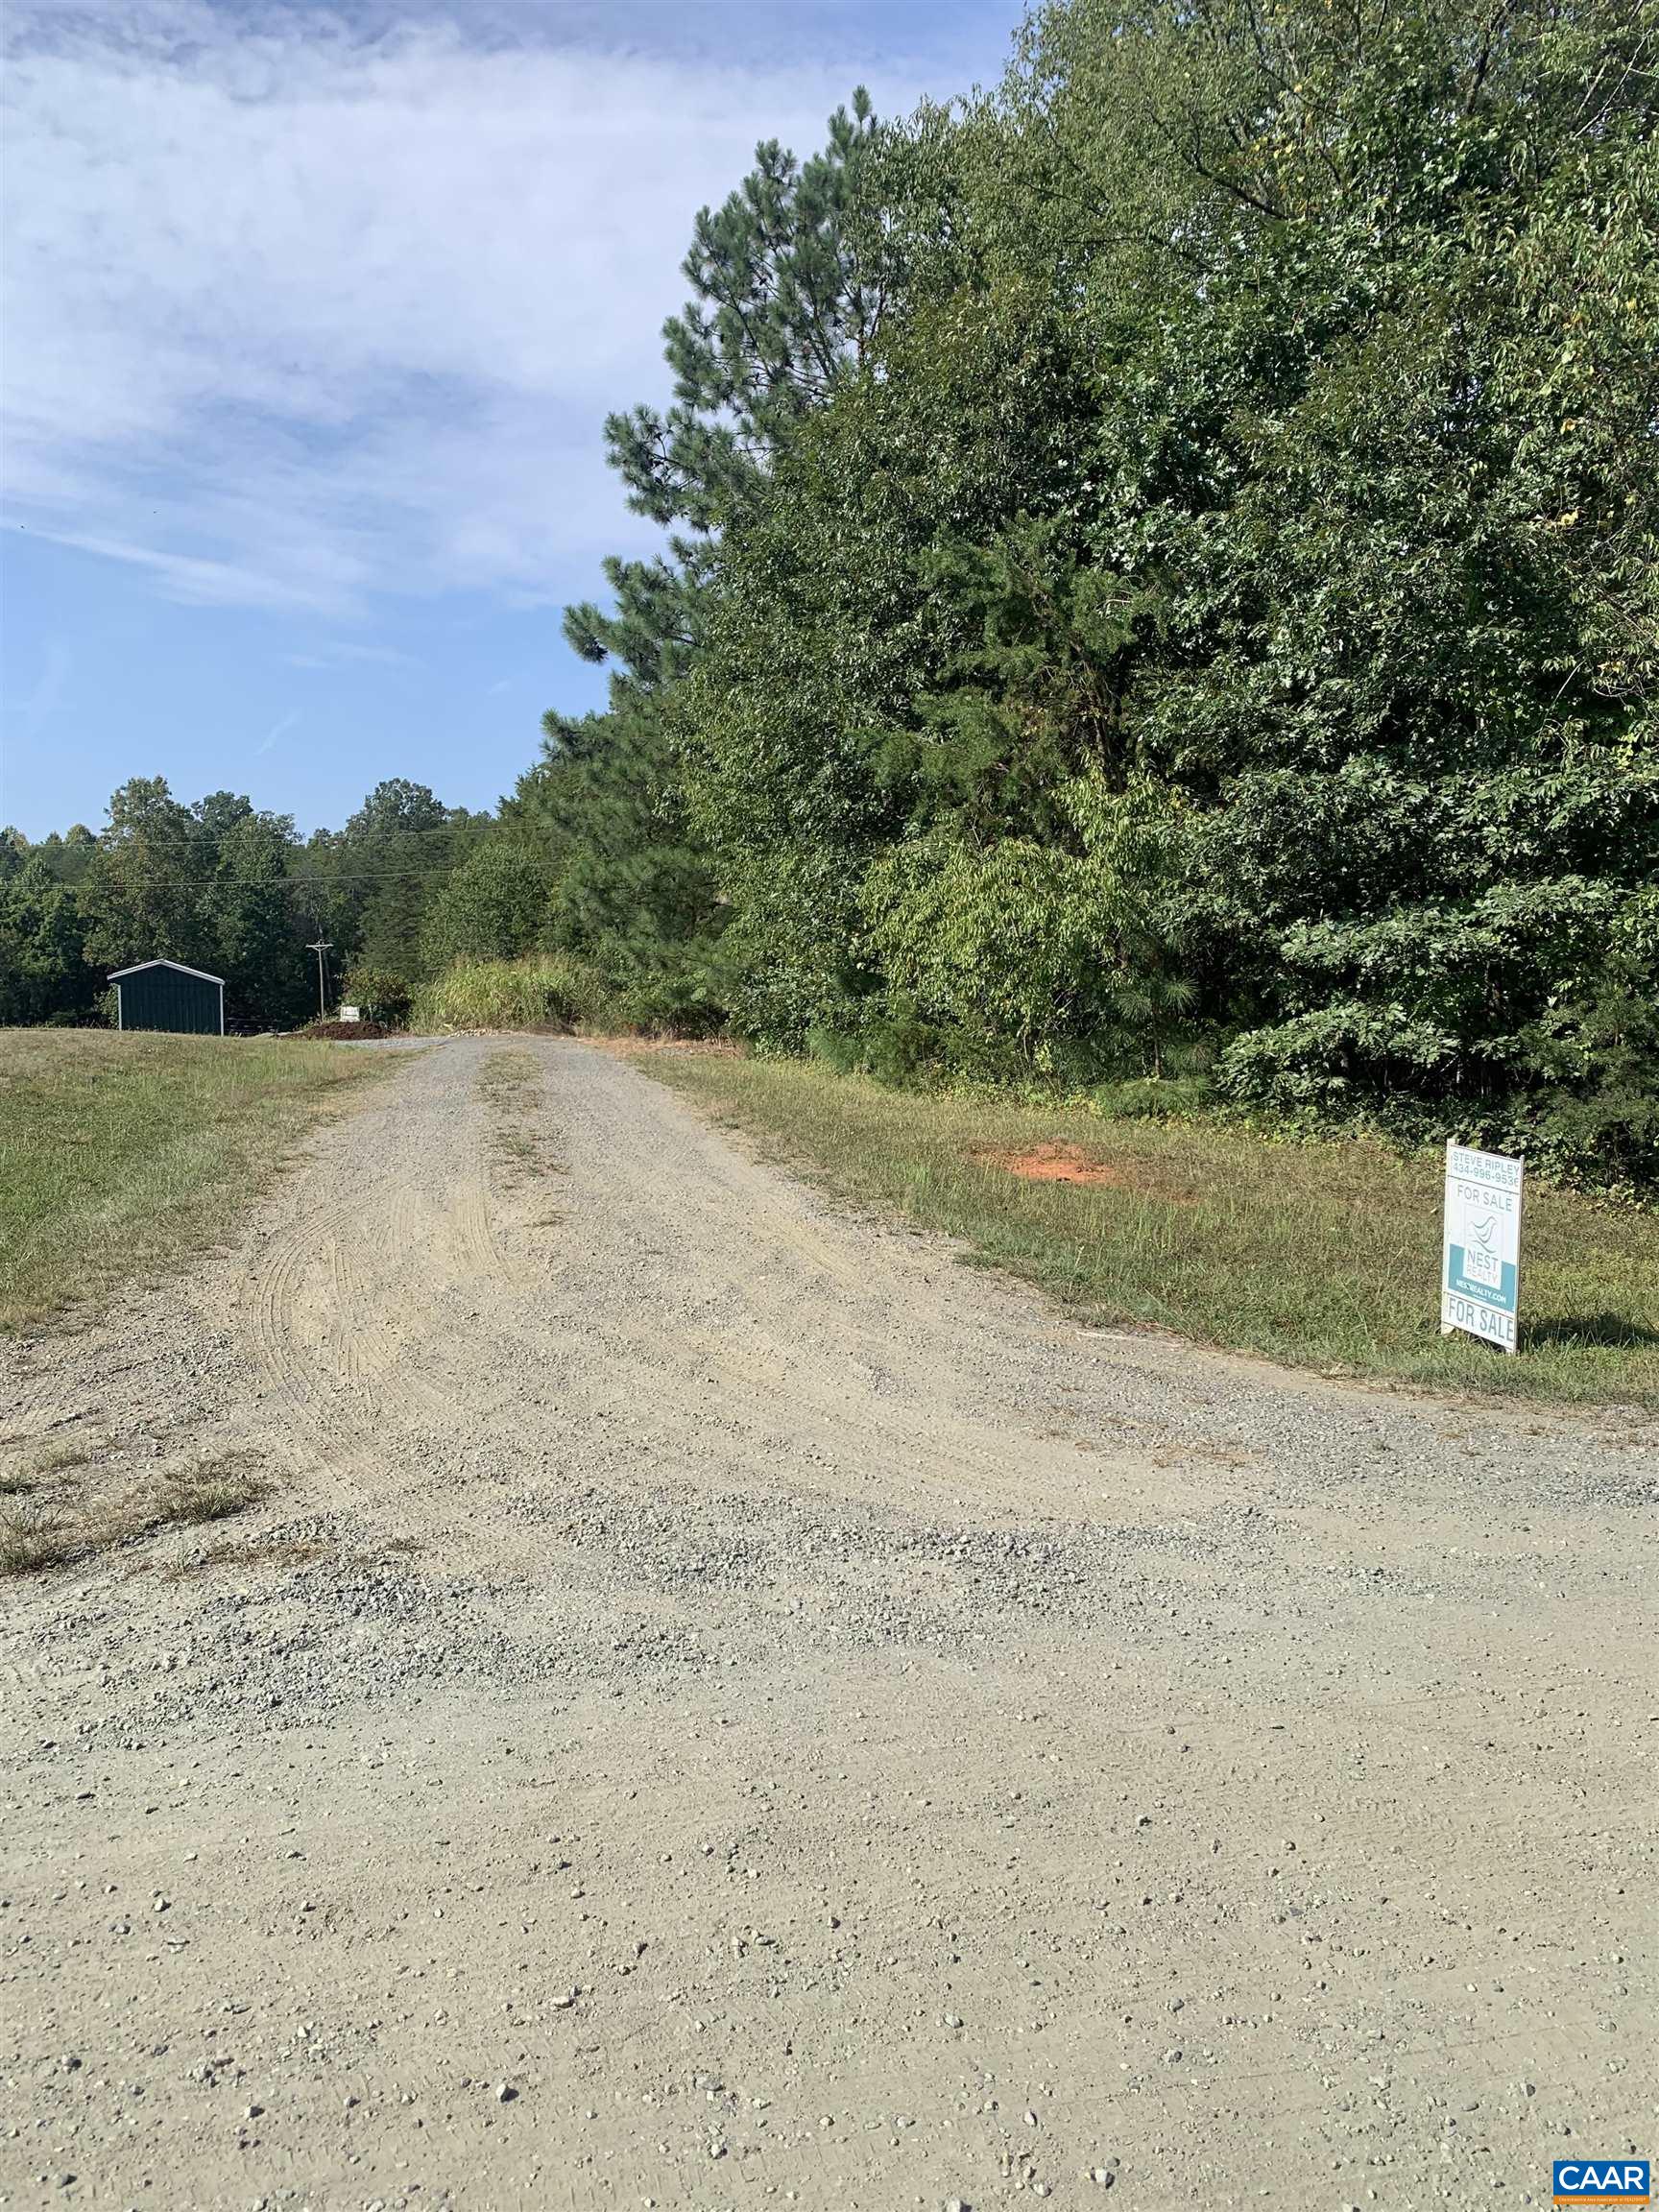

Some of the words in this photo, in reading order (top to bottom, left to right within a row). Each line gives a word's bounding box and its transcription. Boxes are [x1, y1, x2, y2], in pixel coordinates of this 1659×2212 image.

[1453, 1151, 1482, 1167] STEVE
[1484, 1159, 1520, 1176] RIPLEY
[1457, 1184, 1479, 1204] FOR
[1483, 1191, 1512, 1212] SALE
[1467, 1249, 1498, 1271] NEST
[1467, 1264, 1498, 1284] REALTY
[1449, 1297, 1474, 1328] FOR
[1479, 1309, 1514, 1342] SALE
